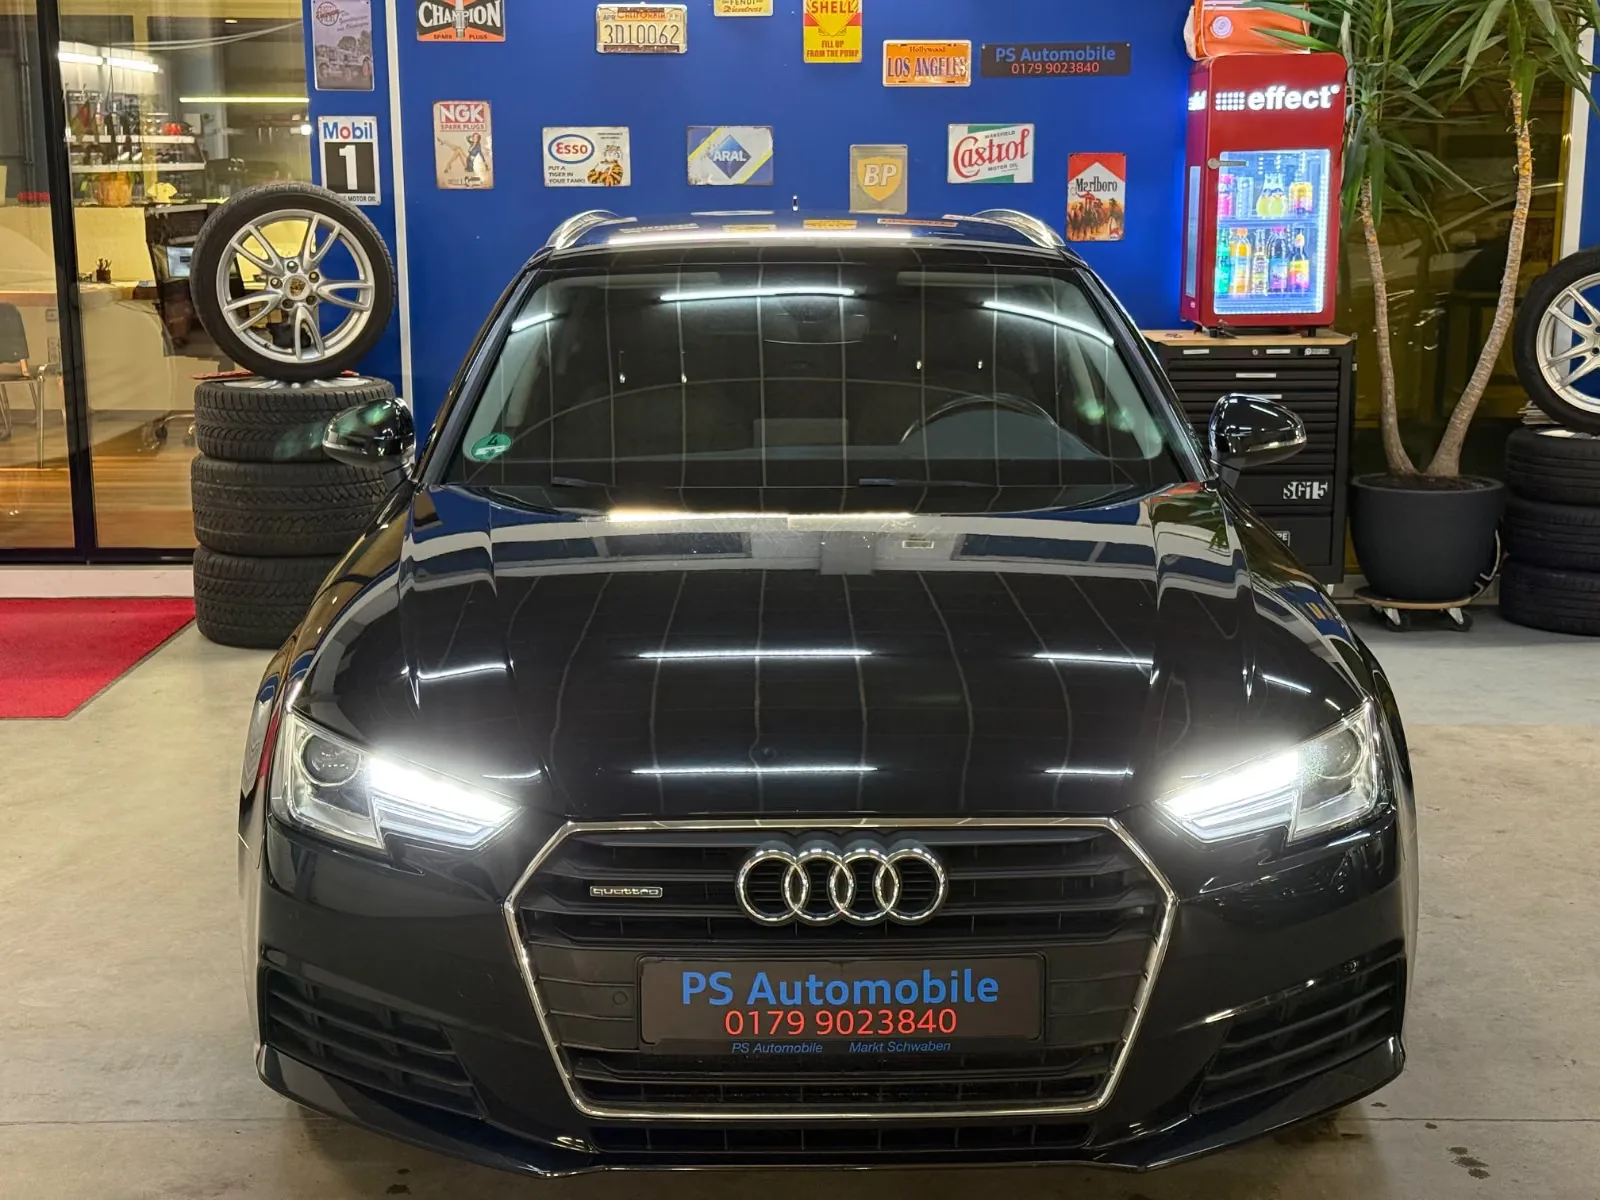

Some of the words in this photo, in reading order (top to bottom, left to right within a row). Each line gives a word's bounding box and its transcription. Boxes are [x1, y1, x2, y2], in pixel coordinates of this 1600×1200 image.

[418, 0, 501, 28] CHAMPION
[811, 1, 855, 14] SHELL
[604, 24, 680, 44] 3D10062
[806, 49, 825, 57] FROM
[827, 49, 839, 57] THE
[840, 49, 859, 57] PUMP
[821, 40, 833, 48] FILL
[835, 40, 845, 48] UP
[995, 47, 1016, 62] PS
[1020, 45, 1116, 62] Automobile
[887, 57, 911, 77] LOS
[915, 57, 967, 77] ANGELES
[1011, 63, 1042, 74] 0179
[1045, 62, 1100, 74] 9023840
[440, 104, 485, 123] NGK
[322, 121, 373, 140] Mobil
[712, 150, 747, 162] ARAL
[953, 128, 1030, 179] Castrol
[339, 144, 358, 191] 1
[863, 163, 897, 186] BP
[987, 164, 1008, 172] MOTOR
[1075, 175, 1118, 193] Marlboro
[486, 434, 499, 446] 4
[592, 887, 660, 896] quattro
[682, 971, 734, 1006] PS
[746, 968, 999, 1006] Automobile
[724, 1009, 805, 1035] 0179
[815, 1008, 957, 1035] 9023840
[731, 1042, 750, 1054] PS
[752, 1042, 823, 1054] Automobile
[849, 1041, 885, 1053] Markt
[887, 1040, 951, 1052] Schwaben
